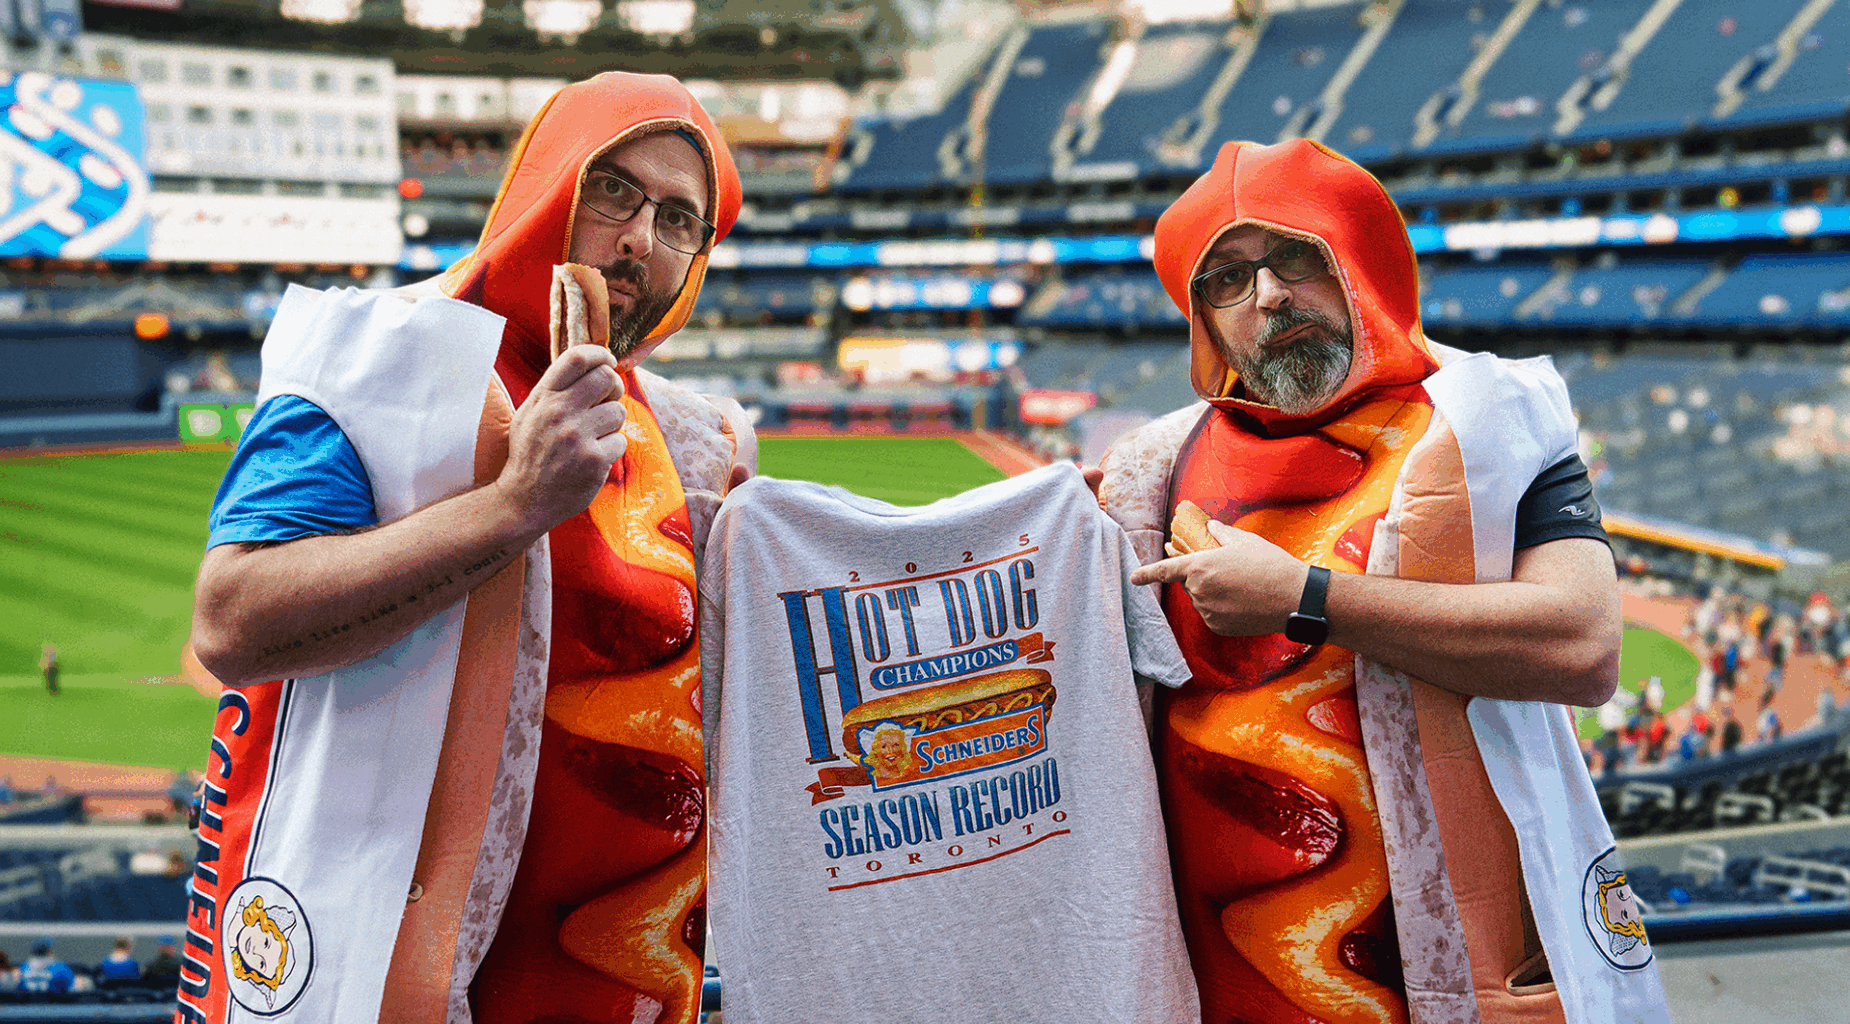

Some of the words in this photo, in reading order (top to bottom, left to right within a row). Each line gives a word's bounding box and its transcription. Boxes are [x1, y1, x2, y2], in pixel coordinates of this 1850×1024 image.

[359, 603, 398, 624] like
[463, 549, 508, 576] count
[848, 534, 1029, 582] 2025
[777, 585, 922, 765] HOT
[936, 558, 1040, 649] DOG
[877, 643, 1015, 687] CHAMPIONS
[916, 714, 1040, 773] SCHNEIDERS
[819, 790, 944, 860] SEASON
[948, 757, 1062, 836] RECORD
[826, 810, 1068, 879] TORONTO
